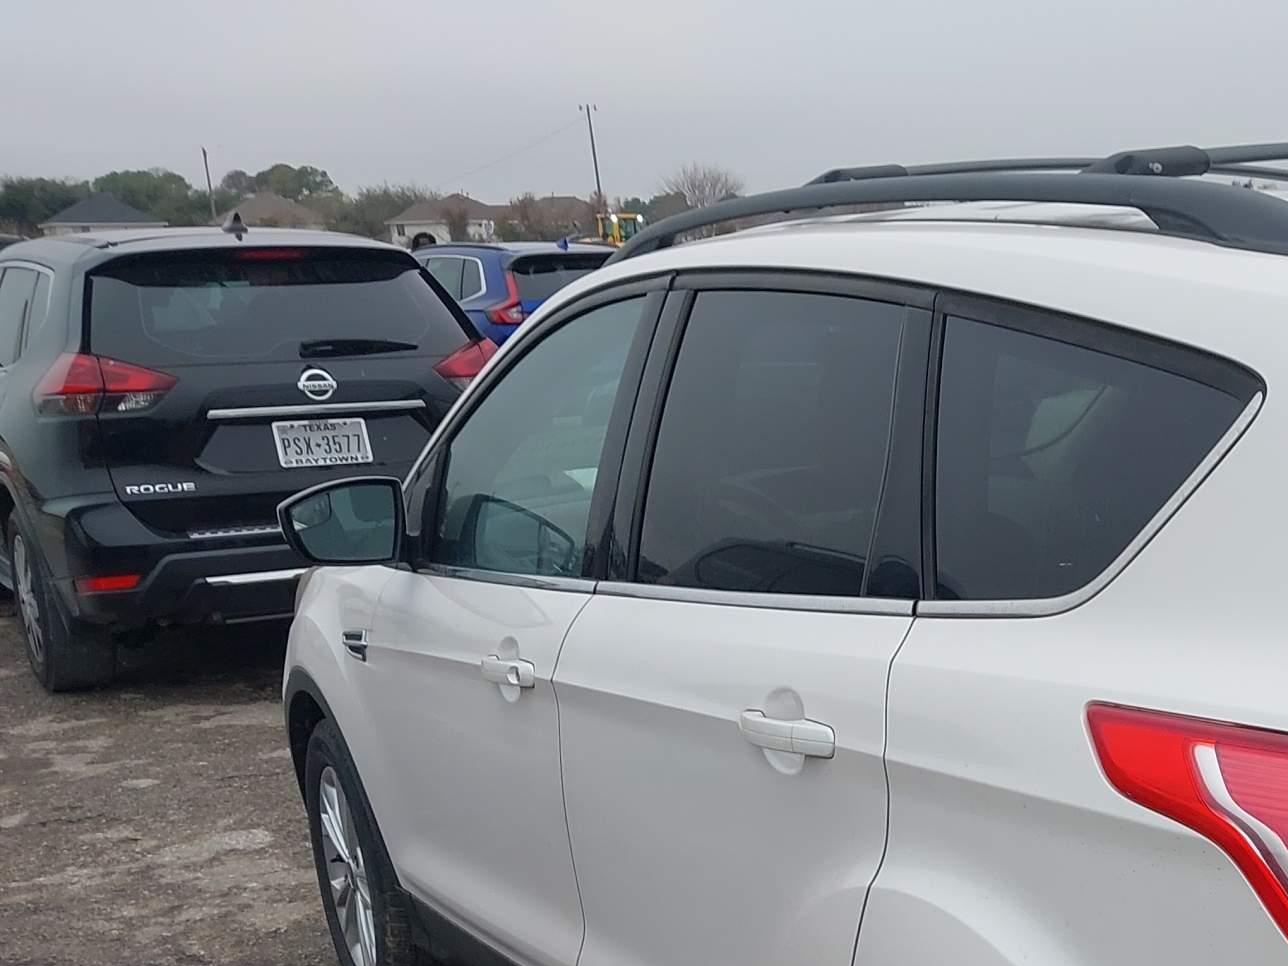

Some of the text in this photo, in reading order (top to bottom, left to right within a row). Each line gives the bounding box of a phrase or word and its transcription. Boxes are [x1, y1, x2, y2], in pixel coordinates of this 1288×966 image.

[302, 382, 335, 390] NISSAN
[303, 422, 337, 433] TEXAS
[295, 454, 360, 466] BAYTOWN
[125, 481, 197, 496] ROGUE
